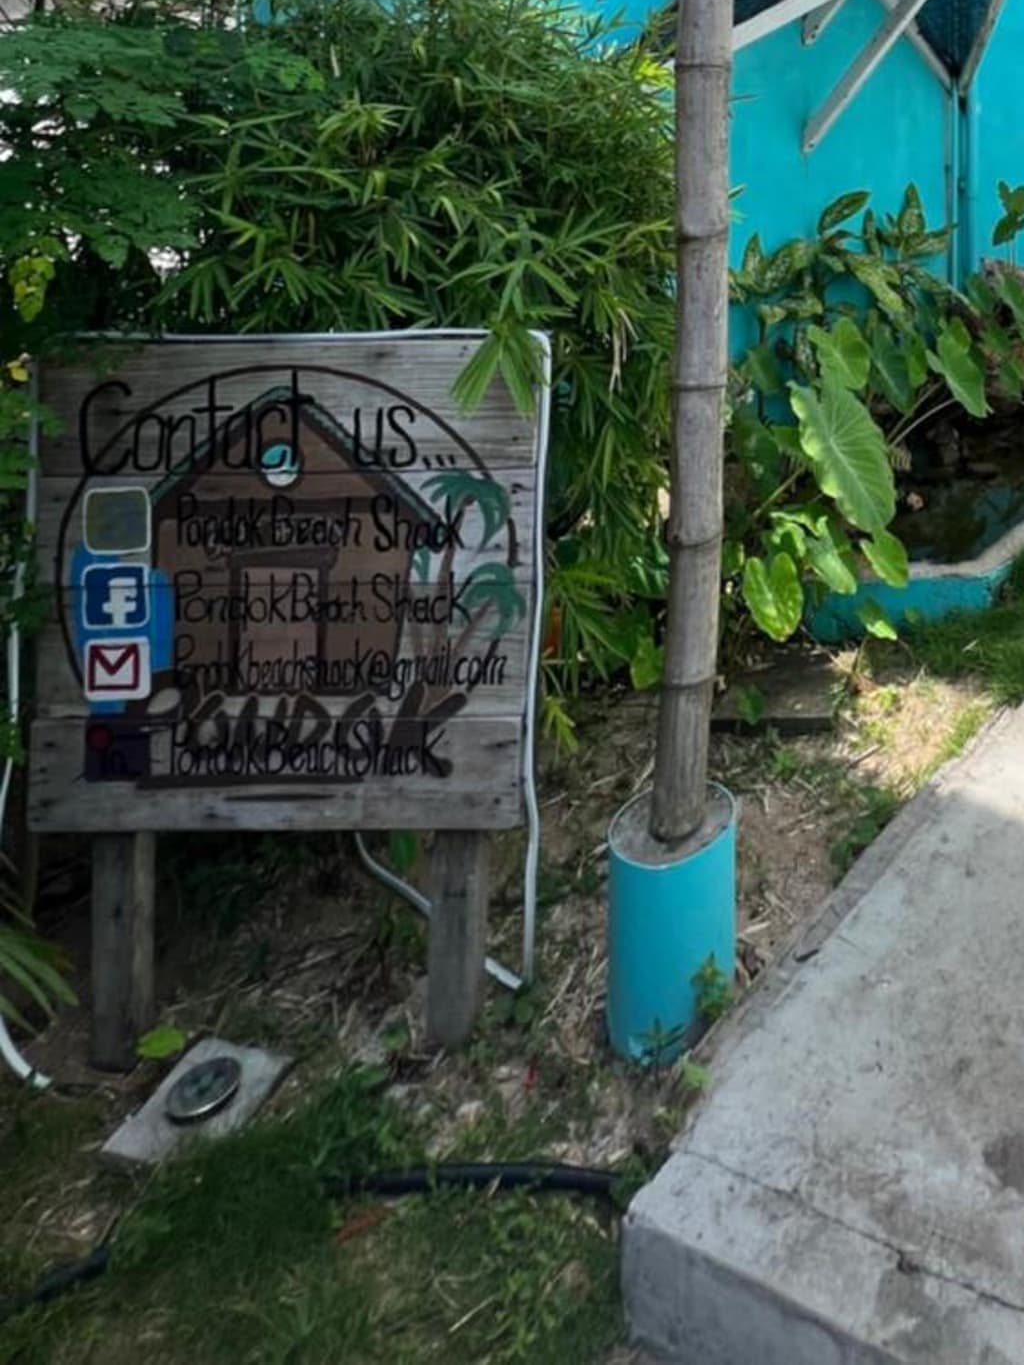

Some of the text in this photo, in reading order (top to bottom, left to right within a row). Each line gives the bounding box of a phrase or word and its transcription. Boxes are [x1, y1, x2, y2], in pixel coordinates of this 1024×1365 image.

[81, 369, 456, 474] Contact us...
[271, 494, 361, 547] Beach
[371, 493, 466, 554] Shack
